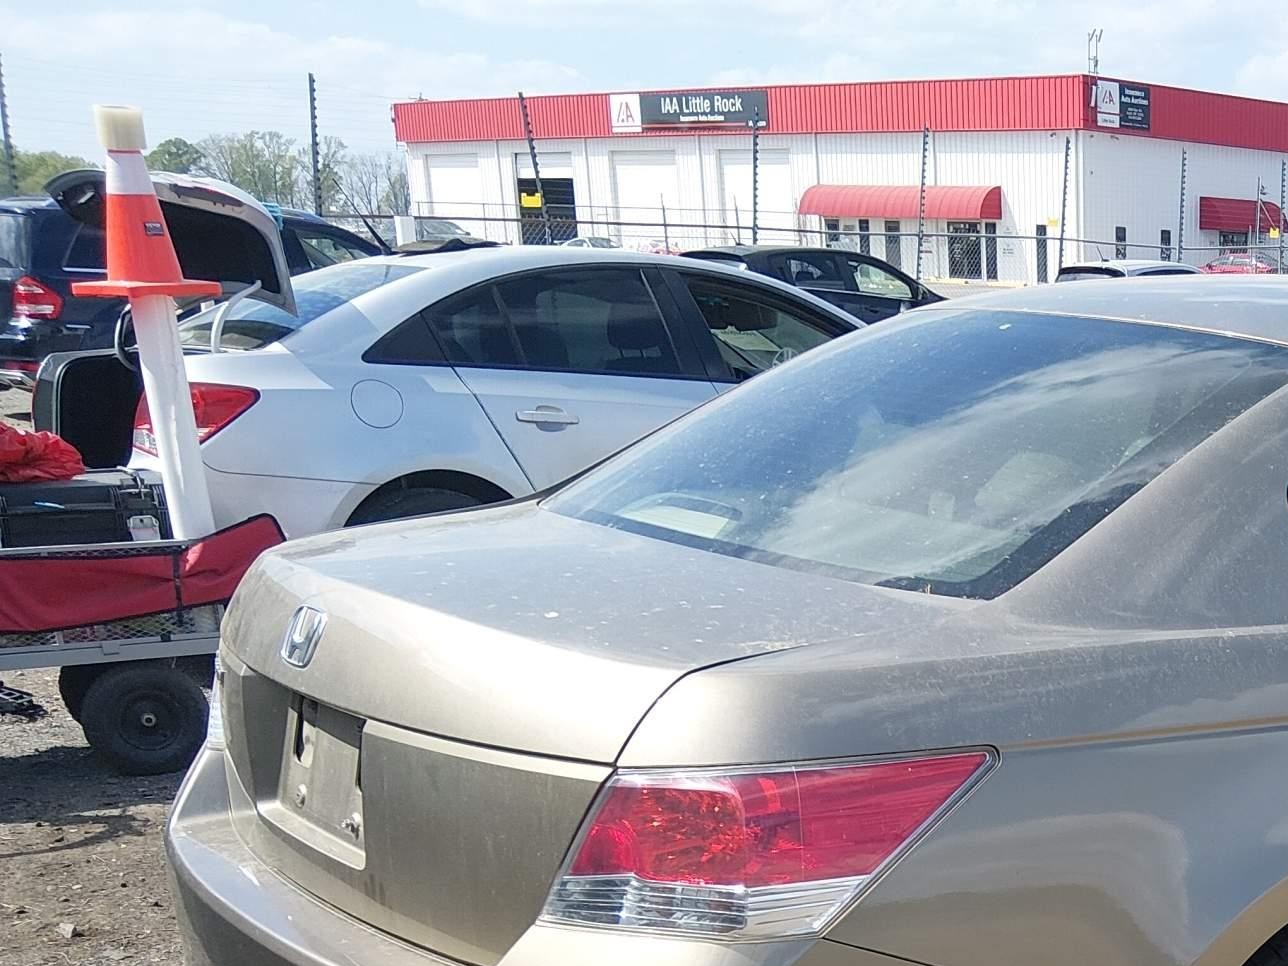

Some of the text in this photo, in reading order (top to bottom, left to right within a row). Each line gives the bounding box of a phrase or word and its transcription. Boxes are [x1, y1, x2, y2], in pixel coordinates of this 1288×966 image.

[661, 94, 743, 114] IAA Little Rock
